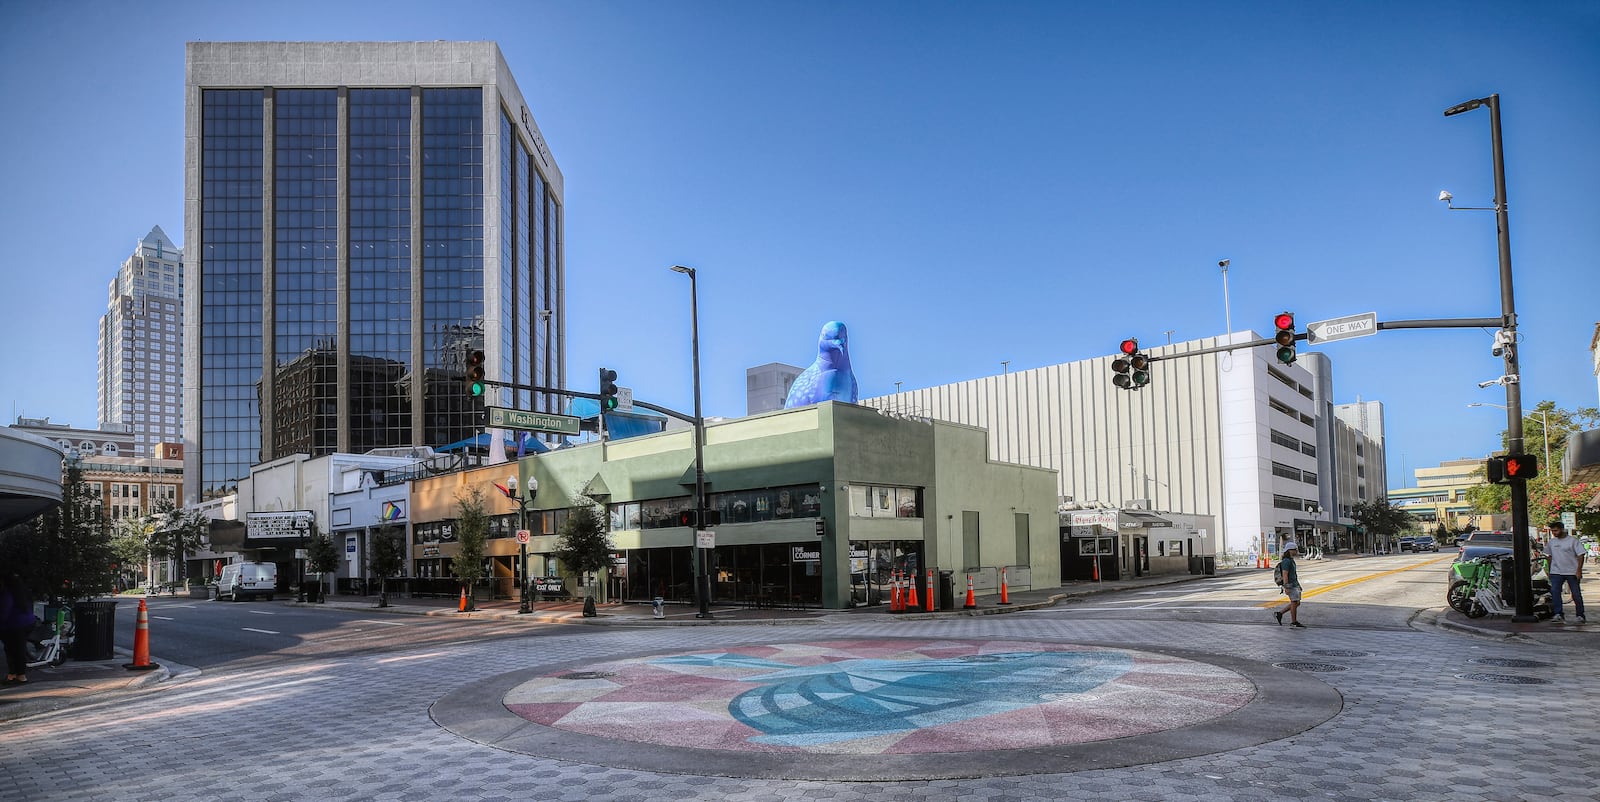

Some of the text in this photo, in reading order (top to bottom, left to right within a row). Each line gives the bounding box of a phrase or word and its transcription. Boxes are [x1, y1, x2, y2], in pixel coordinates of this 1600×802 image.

[1326, 320, 1368, 335] ONE WAY
[508, 412, 562, 429] Washington
